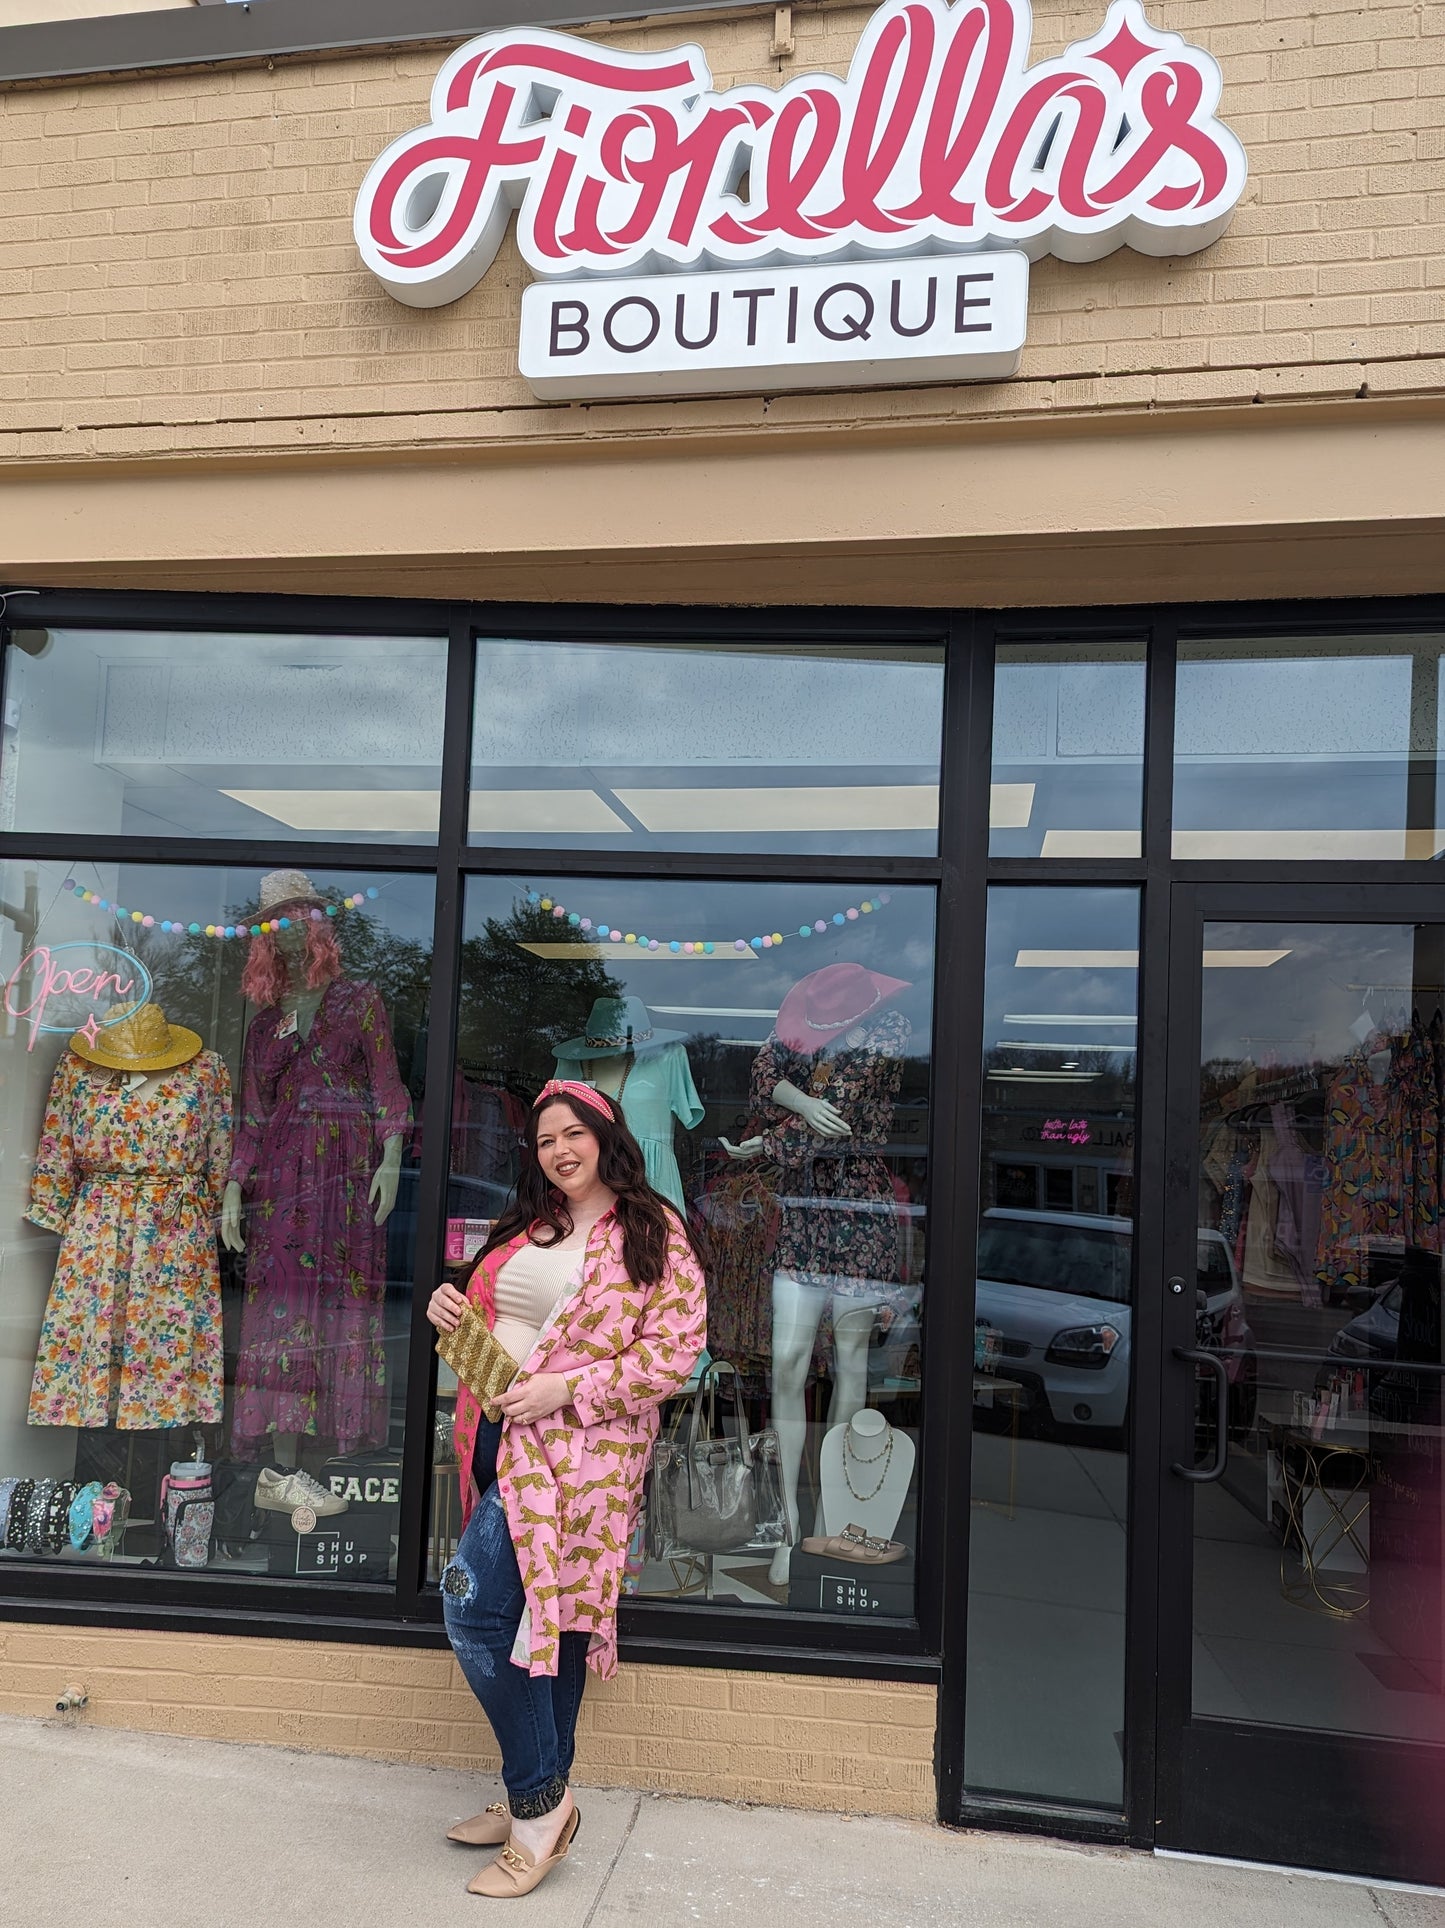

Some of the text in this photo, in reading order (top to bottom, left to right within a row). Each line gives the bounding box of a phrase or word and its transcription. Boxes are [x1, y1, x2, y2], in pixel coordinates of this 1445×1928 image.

[369, 0, 1227, 268] Fiorella's
[548, 272, 994, 358] BOUTIQUE
[5, 947, 135, 1052] Open
[1067, 1130, 1090, 1144] ugly
[329, 1475, 399, 1502] FACE
[317, 1541, 354, 1552] SHU
[316, 1553, 368, 1565] SHOP
[837, 1585, 867, 1597] SHU
[836, 1595, 879, 1608] SHOP
